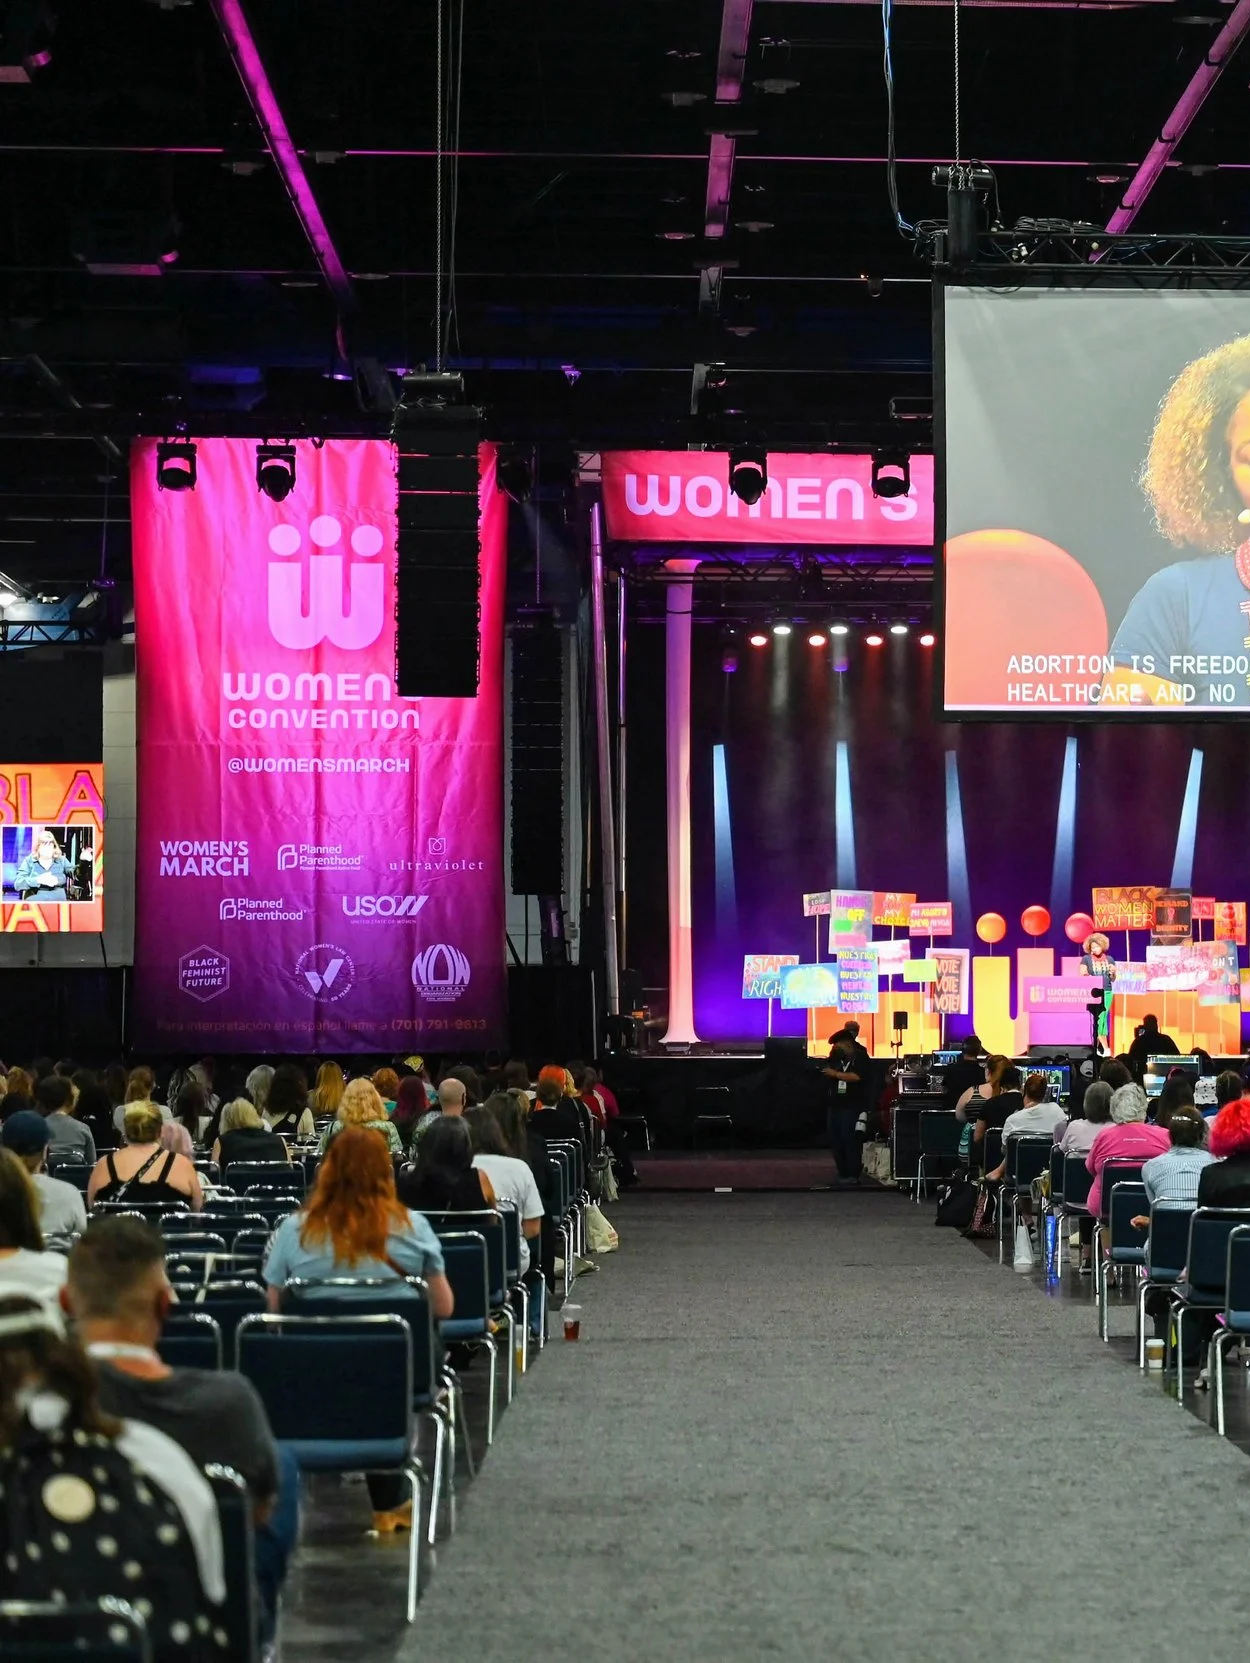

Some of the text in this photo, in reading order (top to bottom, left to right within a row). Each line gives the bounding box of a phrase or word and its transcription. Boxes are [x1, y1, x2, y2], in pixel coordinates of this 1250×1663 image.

[625, 473, 918, 521] WOMENS
[1007, 655, 1115, 675] ABORTION
[1131, 655, 1155, 675] IS
[223, 672, 423, 701] WOMEN
[1007, 684, 1143, 703] HEALTHCARE
[1156, 684, 1196, 703] AND
[1210, 684, 1236, 703] NO
[228, 708, 420, 729] CONVENTION
[160, 840, 249, 856] WOMEN'S
[300, 844, 342, 854] Planned
[160, 856, 249, 877] MARCH
[389, 860, 484, 871] ultraviolet
[1095, 888, 1152, 901] BLACK
[237, 898, 283, 909] Planned
[1095, 902, 1153, 914] WOMEN
[874, 916, 911, 925] CHOIC
[1094, 913, 1155, 929] MATTER
[189, 957, 220, 967] BLACK
[411, 943, 471, 985] NOW
[936, 959, 960, 974] VOTE
[182, 967, 226, 978] FEMINIST
[186, 977, 223, 988] FUTURE
[935, 975, 960, 992] VOTE
[391, 1019, 423, 1032] (701)
[427, 1019, 487, 1030] 791-9613
